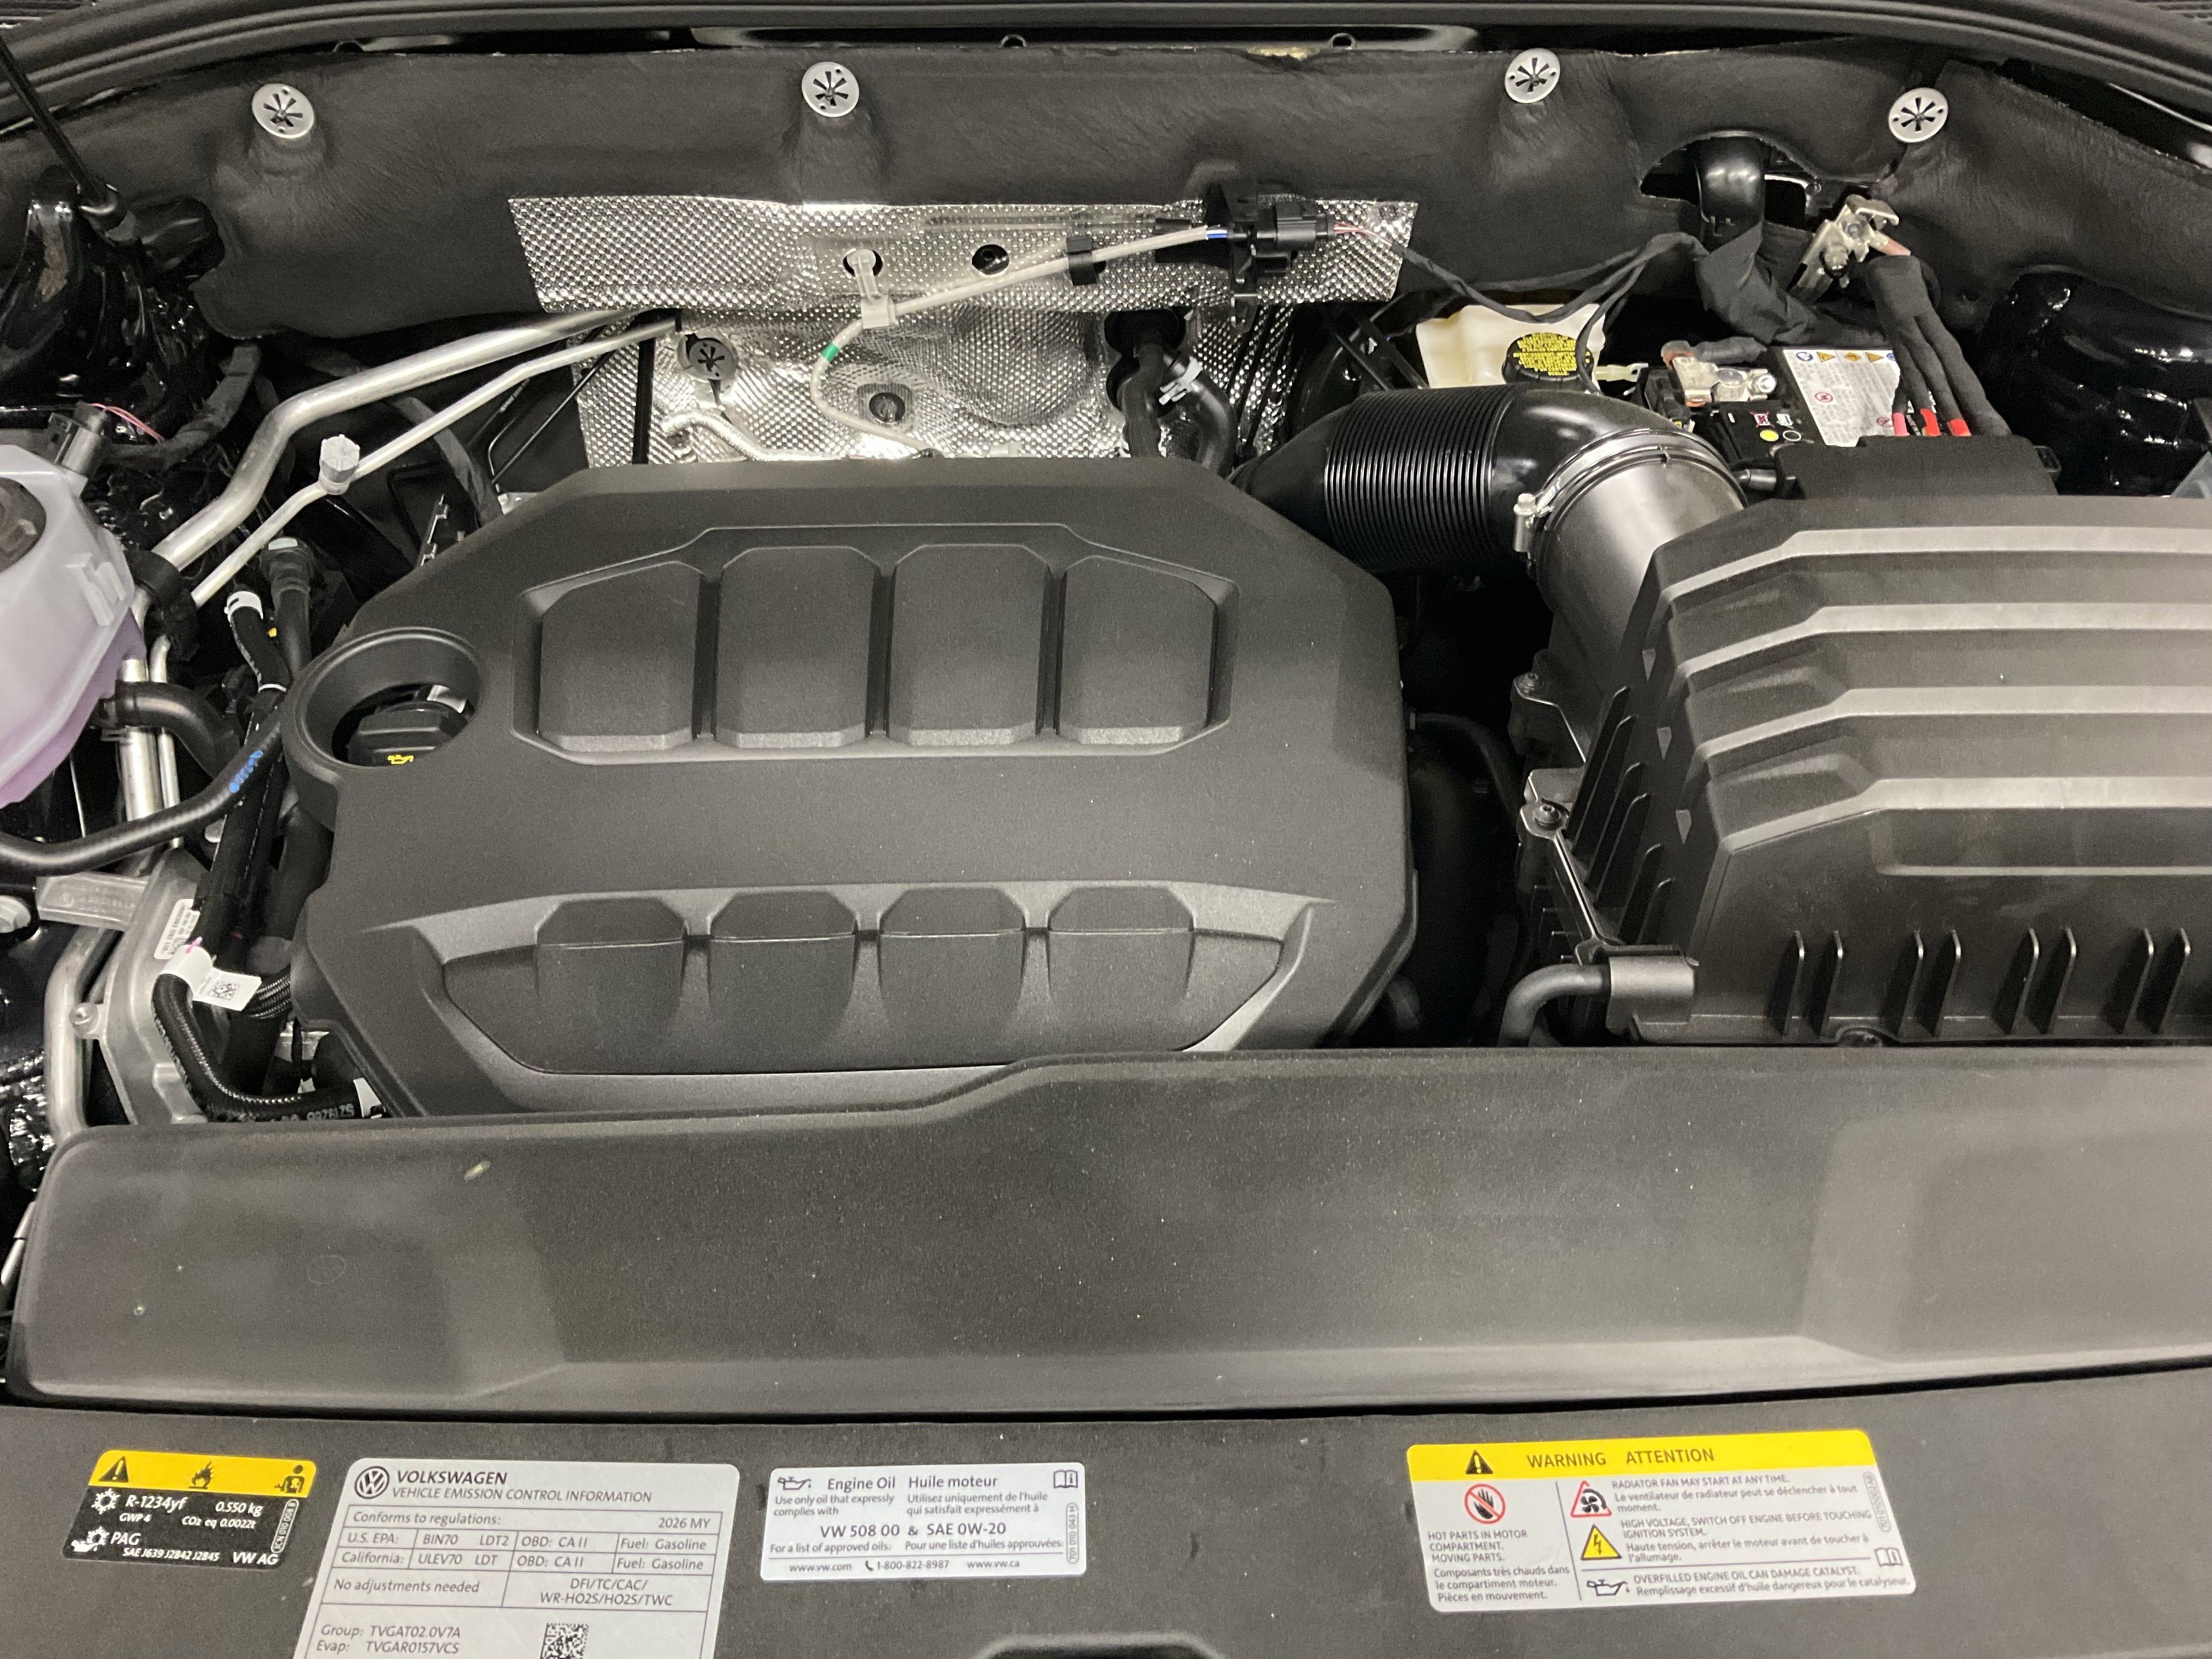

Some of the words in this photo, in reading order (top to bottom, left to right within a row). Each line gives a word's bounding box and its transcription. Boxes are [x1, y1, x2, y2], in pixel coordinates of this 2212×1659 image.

[1527, 1452, 1606, 1468] WARNING
[1626, 1449, 1715, 1464] ATTENTION
[397, 1470, 507, 1485] VOLKSWAGEN
[909, 1476, 944, 1488] Huile
[948, 1476, 998, 1488] moteur
[1612, 1479, 1658, 1489] RADIATOR
[1661, 1479, 1679, 1487] FAN
[1681, 1477, 1701, 1486] MAY
[1702, 1476, 1730, 1486] START
[1745, 1475, 1763, 1483] ANY
[1764, 1475, 1790, 1483] TIME.
[827, 1478, 873, 1493] Engine
[877, 1476, 895, 1488] Oil
[392, 1487, 441, 1499] VEHICLE
[444, 1488, 504, 1500] EMISSION
[506, 1489, 562, 1502] CONTROL
[566, 1491, 652, 1503] INFORMATION
[775, 1496, 793, 1504] Use
[794, 1495, 814, 1506] only
[816, 1495, 828, 1504] oil
[830, 1494, 849, 1503] that
[851, 1493, 894, 1505] expressly
[907, 1493, 942, 1503] Utilisez
[945, 1493, 1002, 1505] uniquement
[1006, 1493, 1017, 1502] de
[1019, 1492, 1048, 1500] l'huile
[1614, 1493, 1626, 1502] Le
[1627, 1491, 1679, 1501] ventilateur
[1681, 1491, 1693, 1499] de
[1696, 1489, 1737, 1498] radiateur
[1741, 1489, 1762, 1499] peut
[1777, 1486, 1827, 1496] déclencher
[1837, 1485, 1858, 1493] tout
[125, 1494, 188, 1513] R-1234yf
[215, 1502, 246, 1513] 0.550
[247, 1503, 263, 1517] kg
[1618, 1504, 1661, 1513] moment.
[774, 1507, 815, 1518] complies
[817, 1506, 838, 1515] with
[907, 1505, 922, 1517] qui
[924, 1504, 962, 1514] satisfait
[964, 1504, 1031, 1517] expressément
[119, 1513, 143, 1522] GWP
[205, 1519, 217, 1529] eq
[353, 1511, 410, 1523] Conforms
[415, 1514, 427, 1523] to
[430, 1513, 501, 1527] regulations:
[658, 1517, 687, 1528] 2026
[690, 1518, 710, 1528] MY
[1621, 1520, 1644, 1528] HIGH
[1646, 1517, 1690, 1527] VOLTAGE,
[1691, 1516, 1727, 1526] SWITCH
[1729, 1516, 1747, 1524] OFF
[1750, 1514, 1784, 1523] ENGINE
[1786, 1513, 1822, 1522] BEFORE
[1825, 1510, 1872, 1520] TOUCHING
[820, 1525, 847, 1538] VW
[850, 1525, 876, 1537] 508
[881, 1524, 900, 1536] 00
[908, 1526, 918, 1536] &
[927, 1523, 953, 1536] SAE
[958, 1522, 1006, 1535] 0W-20
[1428, 1532, 1447, 1540] HOT
[1449, 1531, 1479, 1539] PARTS
[1493, 1530, 1527, 1538] MOTOR
[1623, 1530, 1666, 1538] IGNITION
[1667, 1528, 1707, 1537] SYSTEM.
[110, 1532, 142, 1545] PAG
[347, 1533, 369, 1543] U.S.
[373, 1534, 399, 1544] EPA:
[423, 1534, 458, 1545] BIN70
[479, 1536, 509, 1546] LDT2
[521, 1536, 552, 1547] OBD:
[558, 1537, 575, 1548] CA
[620, 1538, 649, 1549] Fuel:
[655, 1539, 707, 1550] Gasoline
[905, 1541, 927, 1550] Pour
[929, 1542, 946, 1550] une
[949, 1539, 967, 1549] liste
[970, 1539, 1005, 1549] d'huiles
[1007, 1538, 1064, 1551] approuvées:
[1626, 1542, 1656, 1551] Haute
[1658, 1542, 1696, 1551] tension,
[1700, 1539, 1730, 1549] arrêter
[1733, 1539, 1741, 1548] le
[1744, 1537, 1779, 1547] moteur
[1781, 1537, 1808, 1546] avant
[1810, 1536, 1822, 1544] de
[1824, 1534, 1861, 1544] toucher
[770, 1544, 786, 1553] For
[796, 1543, 810, 1551] list
[812, 1543, 823, 1551] of
[825, 1542, 870, 1554] approved
[871, 1541, 891, 1550] oils:
[1430, 1542, 1504, 1551] COMPARTMENT.
[122, 1547, 141, 1557] SAE
[141, 1549, 165, 1558] J639
[164, 1549, 192, 1560] J2842
[192, 1551, 220, 1561] J2845
[233, 1551, 257, 1564] VW
[257, 1554, 279, 1565] AG
[342, 1552, 404, 1564] California:
[418, 1554, 462, 1565] ULEV70
[475, 1555, 498, 1565] LDT
[1432, 1553, 1471, 1563] MOVING
[1473, 1553, 1505, 1561] PARTS.
[1629, 1554, 1682, 1564] l'allumage.
[517, 1555, 548, 1567] OBD:
[555, 1556, 572, 1567] CA
[617, 1558, 645, 1569] Fuel:
[651, 1559, 704, 1570] Gasoline
[789, 1564, 851, 1572] www.vw.com
[877, 1560, 949, 1570] 1-800-822-8987
[967, 1560, 1020, 1568] www.vw.ca
[1434, 1568, 1492, 1578] Composants
[1493, 1567, 1511, 1576] très
[1513, 1566, 1546, 1575] chauds
[1548, 1565, 1570, 1574] dans
[1633, 1573, 1692, 1583] OVERFILLED
[1694, 1572, 1729, 1581] ENGINE
[1731, 1571, 1747, 1579] OIL
[1749, 1570, 1769, 1579] CAN
[1770, 1568, 1811, 1578] DAMAGE
[1813, 1566, 1861, 1576] CATALYST.
[334, 1579, 351, 1590] No
[354, 1579, 431, 1594] adjustments
[435, 1581, 480, 1593] needed
[571, 1578, 648, 1590] DFI/TC/CAC/
[1436, 1581, 1444, 1590] le
[1447, 1579, 1516, 1591] compartiment
[1519, 1579, 1557, 1587] moteur.
[1637, 1587, 1697, 1598] Remplissage
[1699, 1584, 1736, 1594] excessif
[1739, 1582, 1770, 1592] d'huile
[1773, 1582, 1822, 1592] dangereux
[1825, 1581, 1846, 1590] pour
[1848, 1579, 1857, 1588] le
[1859, 1578, 1910, 1588] catalyseur.
[540, 1592, 673, 1606] WR-HO2S/HO2S/TWC
[1438, 1592, 1469, 1602] Pièces
[1486, 1591, 1547, 1601] mouvement.
[321, 1624, 363, 1639] Group:
[370, 1626, 460, 1638] TVGAT02.0V7A
[317, 1640, 349, 1655] Evap:
[366, 1641, 459, 1654] TVGAR0157VCS
